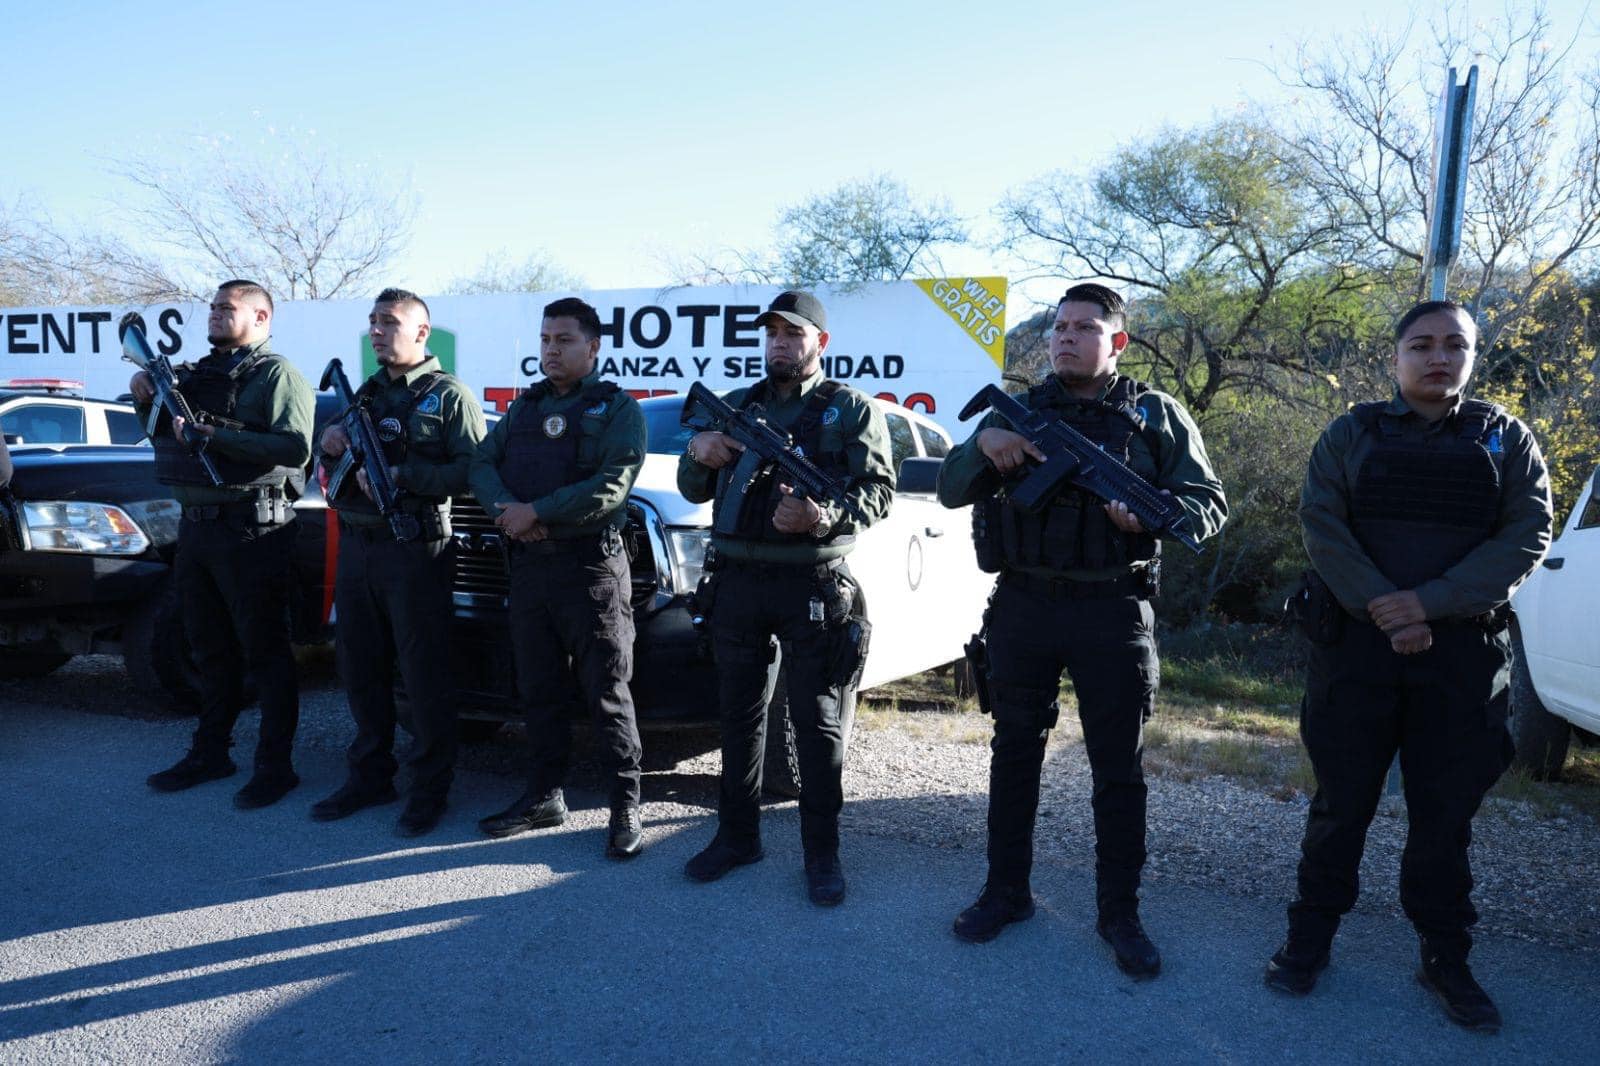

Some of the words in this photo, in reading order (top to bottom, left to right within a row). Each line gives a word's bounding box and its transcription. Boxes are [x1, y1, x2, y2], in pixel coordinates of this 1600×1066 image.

[0, 308, 183, 355] ENTOS
[600, 305, 761, 349] HOTE
[932, 280, 1001, 345] GRATIS
[520, 356, 683, 377] CANZA
[693, 357, 711, 377] Y
[723, 355, 904, 378] SEIDAD
